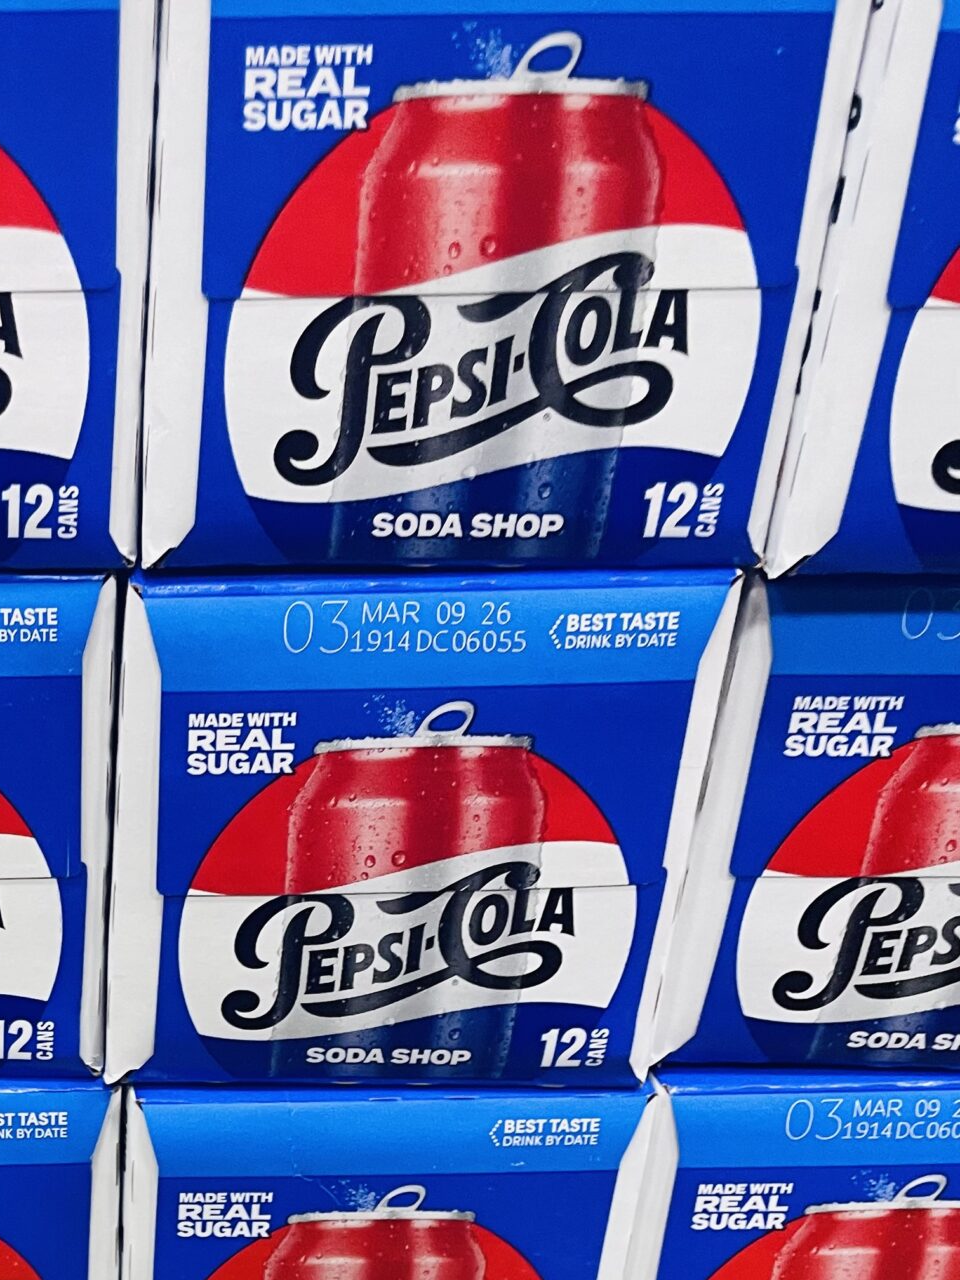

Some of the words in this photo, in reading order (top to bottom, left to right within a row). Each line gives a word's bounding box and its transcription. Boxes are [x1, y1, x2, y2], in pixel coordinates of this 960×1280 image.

[245, 46, 310, 66] MADE
[315, 45, 373, 65] WITH
[243, 68, 371, 98] REAL
[243, 100, 367, 131] SUGAR
[1, 483, 53, 539] 12
[58, 485, 79, 539] CANS
[642, 481, 696, 539] 12
[695, 482, 725, 537] CANS
[371, 513, 467, 538] SODA
[471, 513, 564, 538] SHOP
[0, 608, 58, 625] TASTE
[567, 614, 617, 631] BEST
[620, 611, 680, 630] TASTE
[19, 627, 58, 642] DATE
[283, 601, 349, 653] 03
[362, 602, 420, 622] MAR
[436, 601, 465, 624] 09
[481, 602, 511, 625] 26
[565, 634, 612, 650] DRINK
[615, 633, 635, 648] BY
[637, 632, 677, 647] DATE
[793, 696, 851, 711] MADE
[853, 696, 904, 711] WITH
[188, 714, 244, 728] MADE
[247, 712, 297, 727] WITH
[787, 712, 897, 734] REAL
[188, 729, 295, 751] REAL
[783, 735, 894, 757] SUGAR
[186, 751, 294, 775] SUGAR
[36, 1021, 54, 1060] CANS
[540, 1028, 587, 1067] 12
[583, 1028, 610, 1066] CANS
[847, 1031, 927, 1049] SODA
[306, 1047, 386, 1064] SODA
[391, 1047, 471, 1066] SHOP
[18, 1112, 68, 1126] TASTE
[503, 1120, 547, 1133] BEST
[550, 1118, 600, 1132] TASTE
[785, 1099, 844, 1141] 03
[853, 1100, 902, 1118] MAR
[914, 1100, 941, 1118] 09
[16, 1128, 32, 1139] BY
[35, 1128, 68, 1138] DATE
[502, 1134, 542, 1147] DRINK
[545, 1134, 563, 1146] BY
[564, 1134, 598, 1145] DATE
[179, 1193, 227, 1203] MADE
[230, 1192, 273, 1203] WITH
[698, 1184, 748, 1194] MADE
[750, 1183, 794, 1194] WITH
[178, 1204, 271, 1220] REAL
[694, 1196, 789, 1212] REAL
[176, 1222, 270, 1238] SUGAR
[691, 1213, 785, 1230] SUGAR
